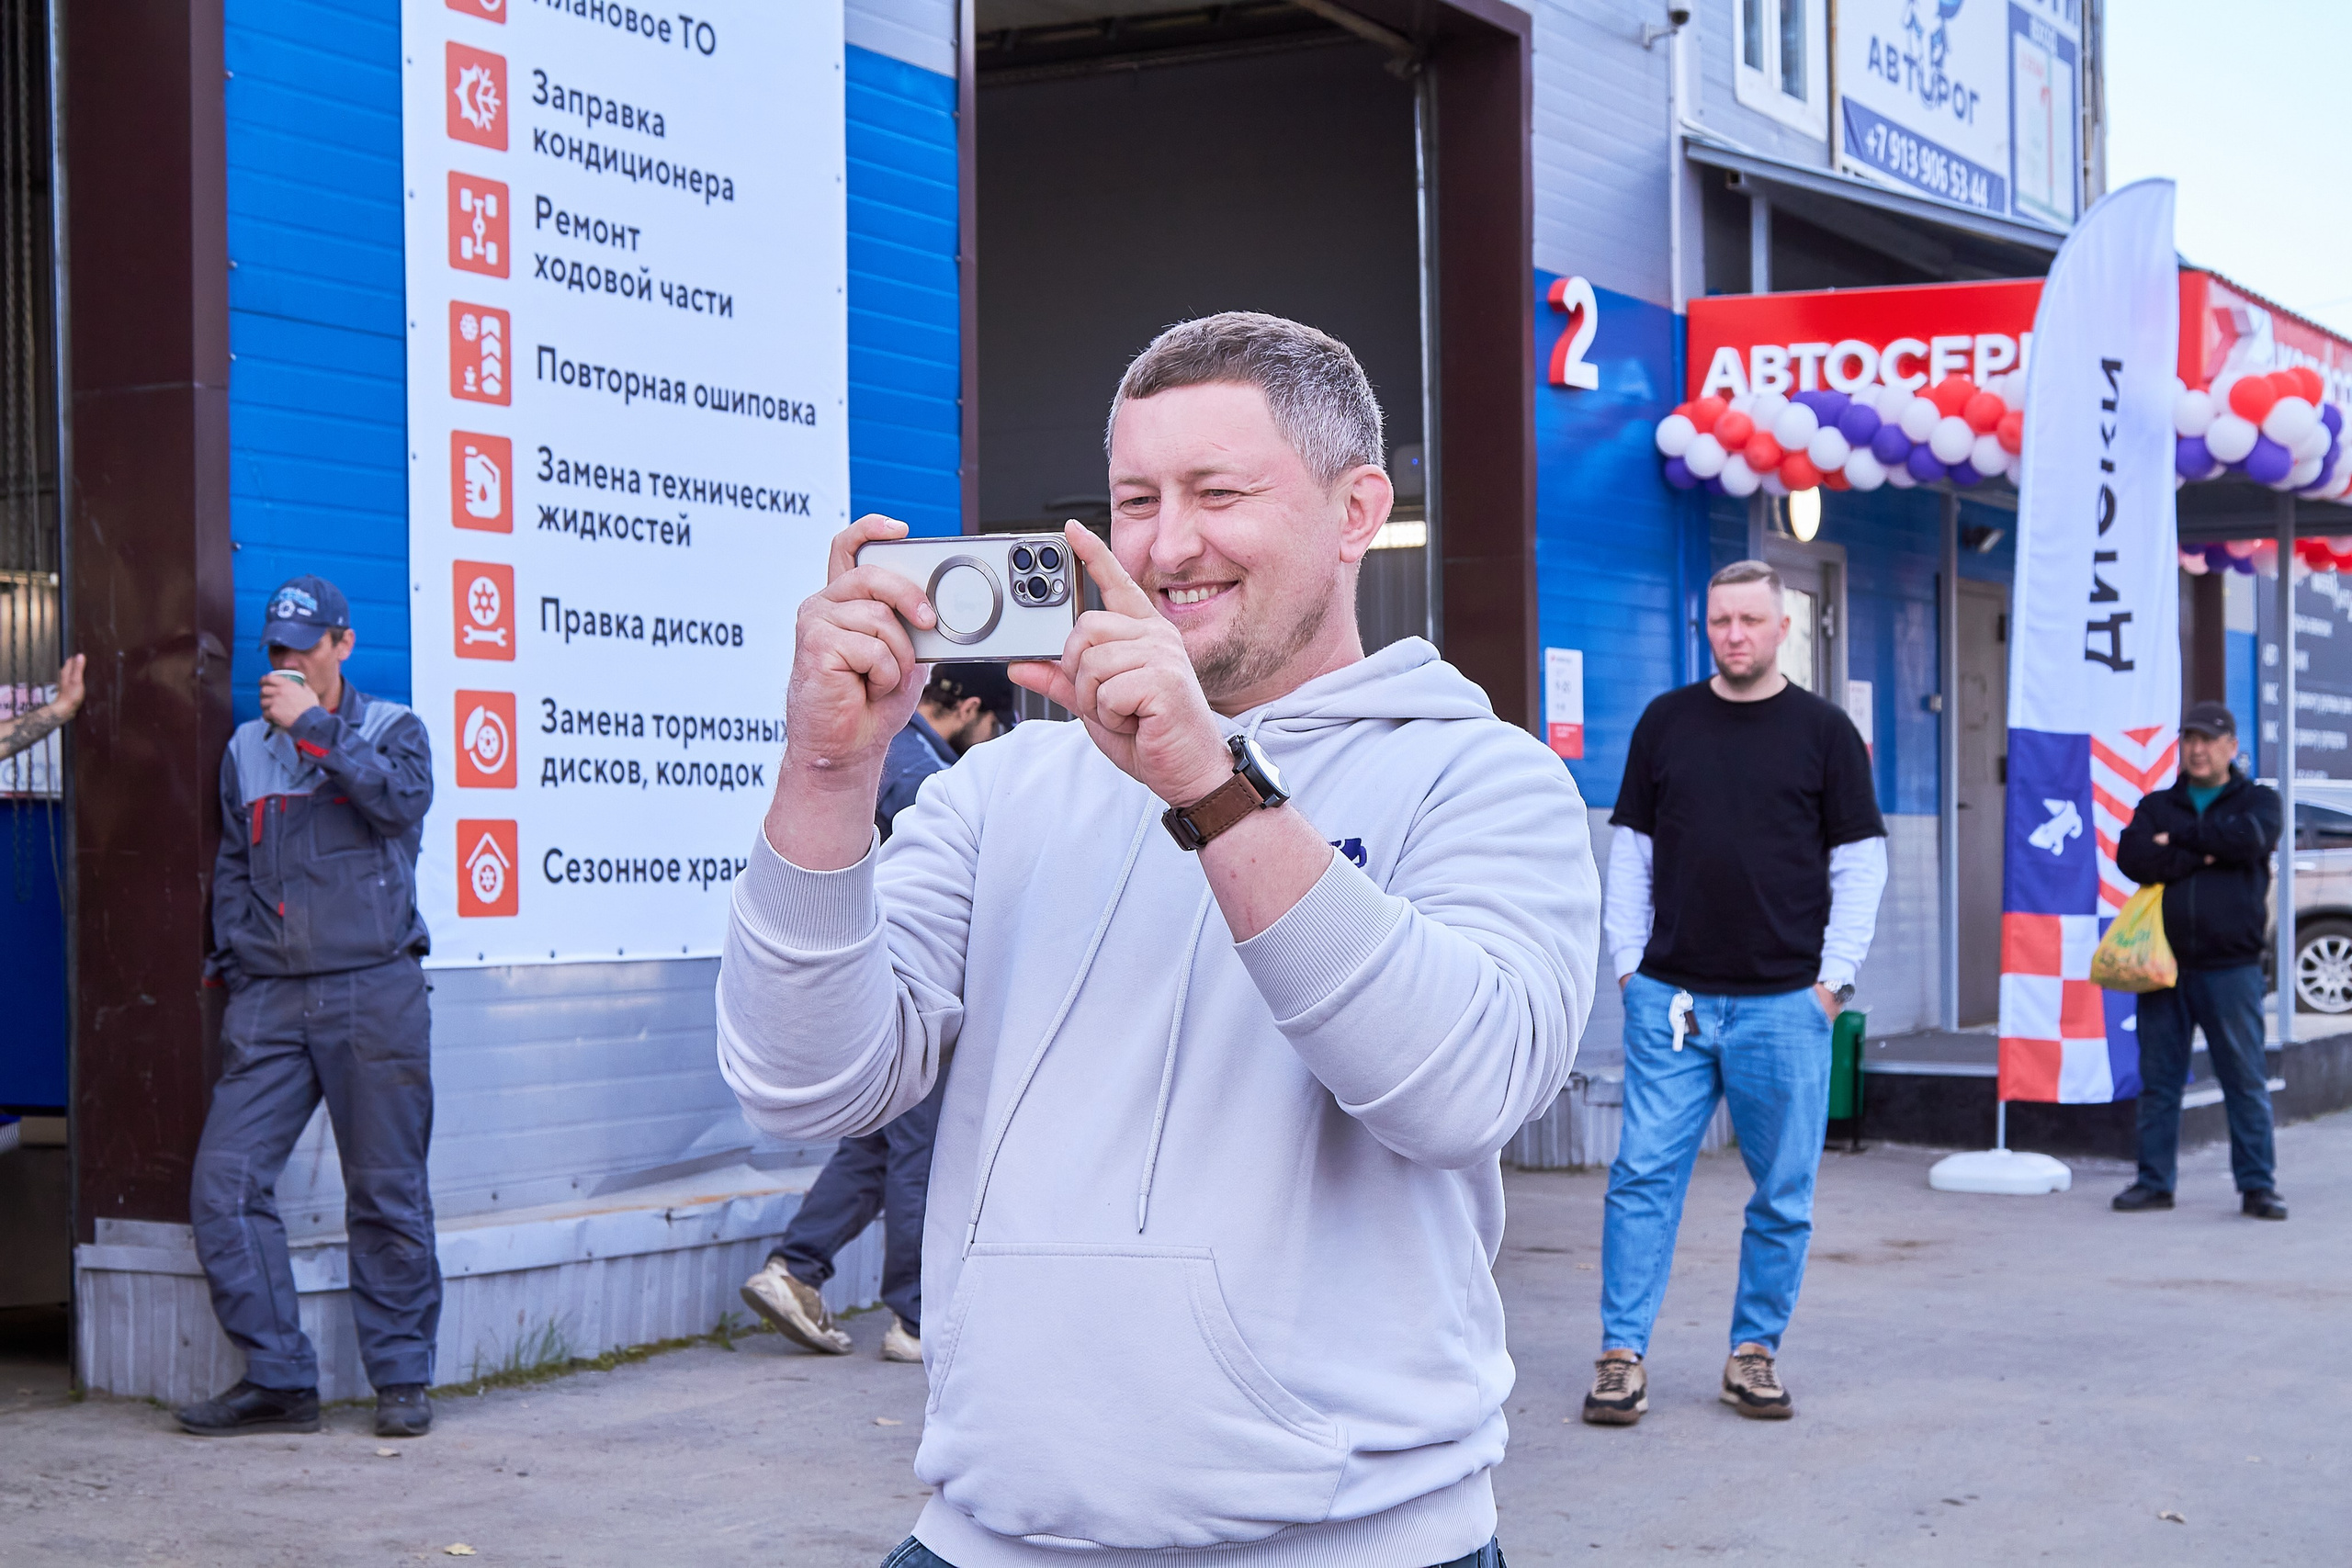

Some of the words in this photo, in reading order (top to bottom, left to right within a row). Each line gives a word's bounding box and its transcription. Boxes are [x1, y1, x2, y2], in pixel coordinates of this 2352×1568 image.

[533, 0, 672, 43] ановое
[678, 14, 717, 56] ТО
[532, 68, 665, 138] Заправка
[534, 128, 734, 205] кондиционера
[536, 194, 640, 252] Ремонт
[535, 254, 652, 301] ходовой
[660, 281, 732, 319] части
[1547, 276, 1599, 390] 2
[537, 344, 686, 405] Повторная
[694, 384, 816, 426] ошиповка
[1702, 332, 2033, 396] АВТОСЕР
[537, 446, 640, 494] Замена
[648, 472, 810, 516] технических
[537, 504, 691, 547] жидкостей
[540, 596, 644, 643] Правка
[651, 617, 744, 648] дисков
[541, 697, 644, 738] Замена
[540, 757, 647, 790] дисков,
[656, 761, 764, 792] колодок
[543, 847, 681, 886] Сезонное
